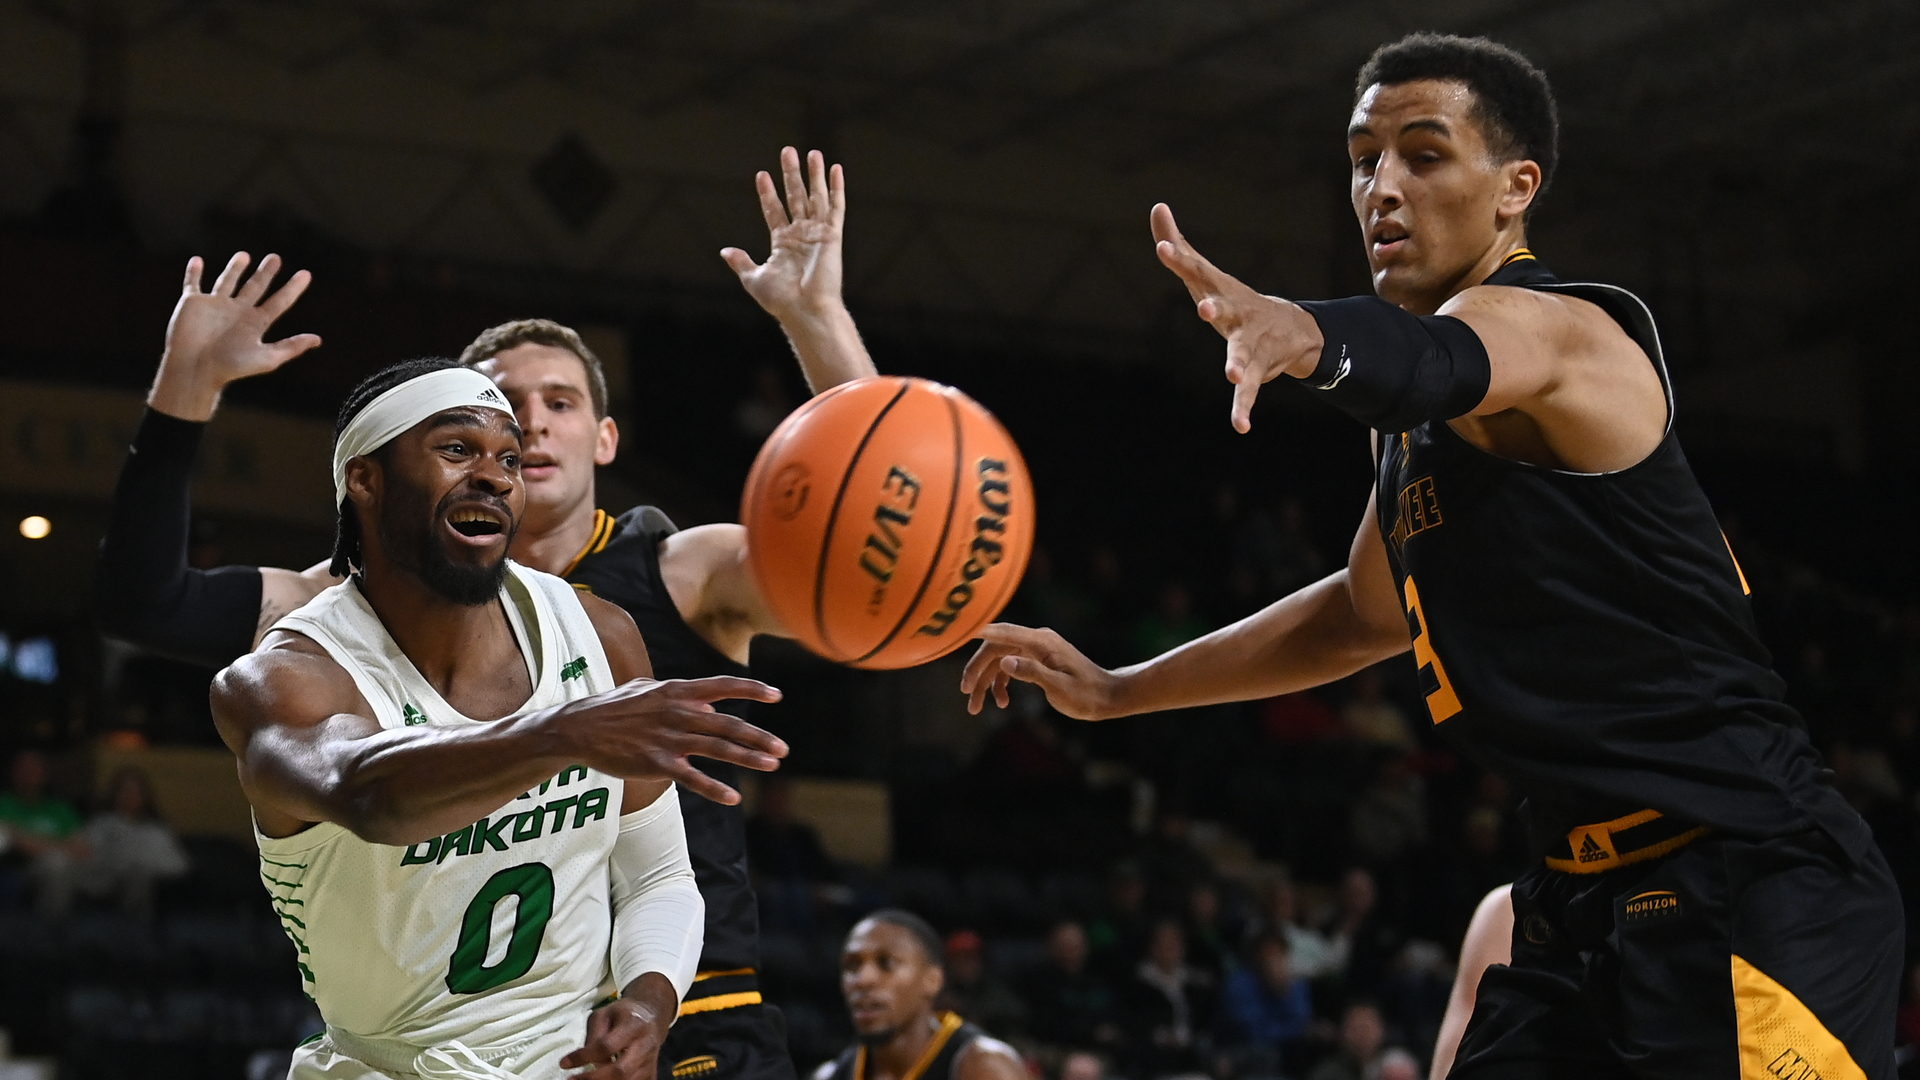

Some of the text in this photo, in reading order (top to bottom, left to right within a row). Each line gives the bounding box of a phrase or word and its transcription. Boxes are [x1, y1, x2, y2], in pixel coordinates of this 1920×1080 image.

[476, 395, 506, 407] adidas
[857, 466, 922, 583] EVO
[912, 456, 1010, 638] Wilson
[400, 788, 609, 867] DAKOTA
[1579, 850, 1610, 863] adidas
[445, 861, 555, 994] 0
[1626, 896, 1677, 914] HORIZON
